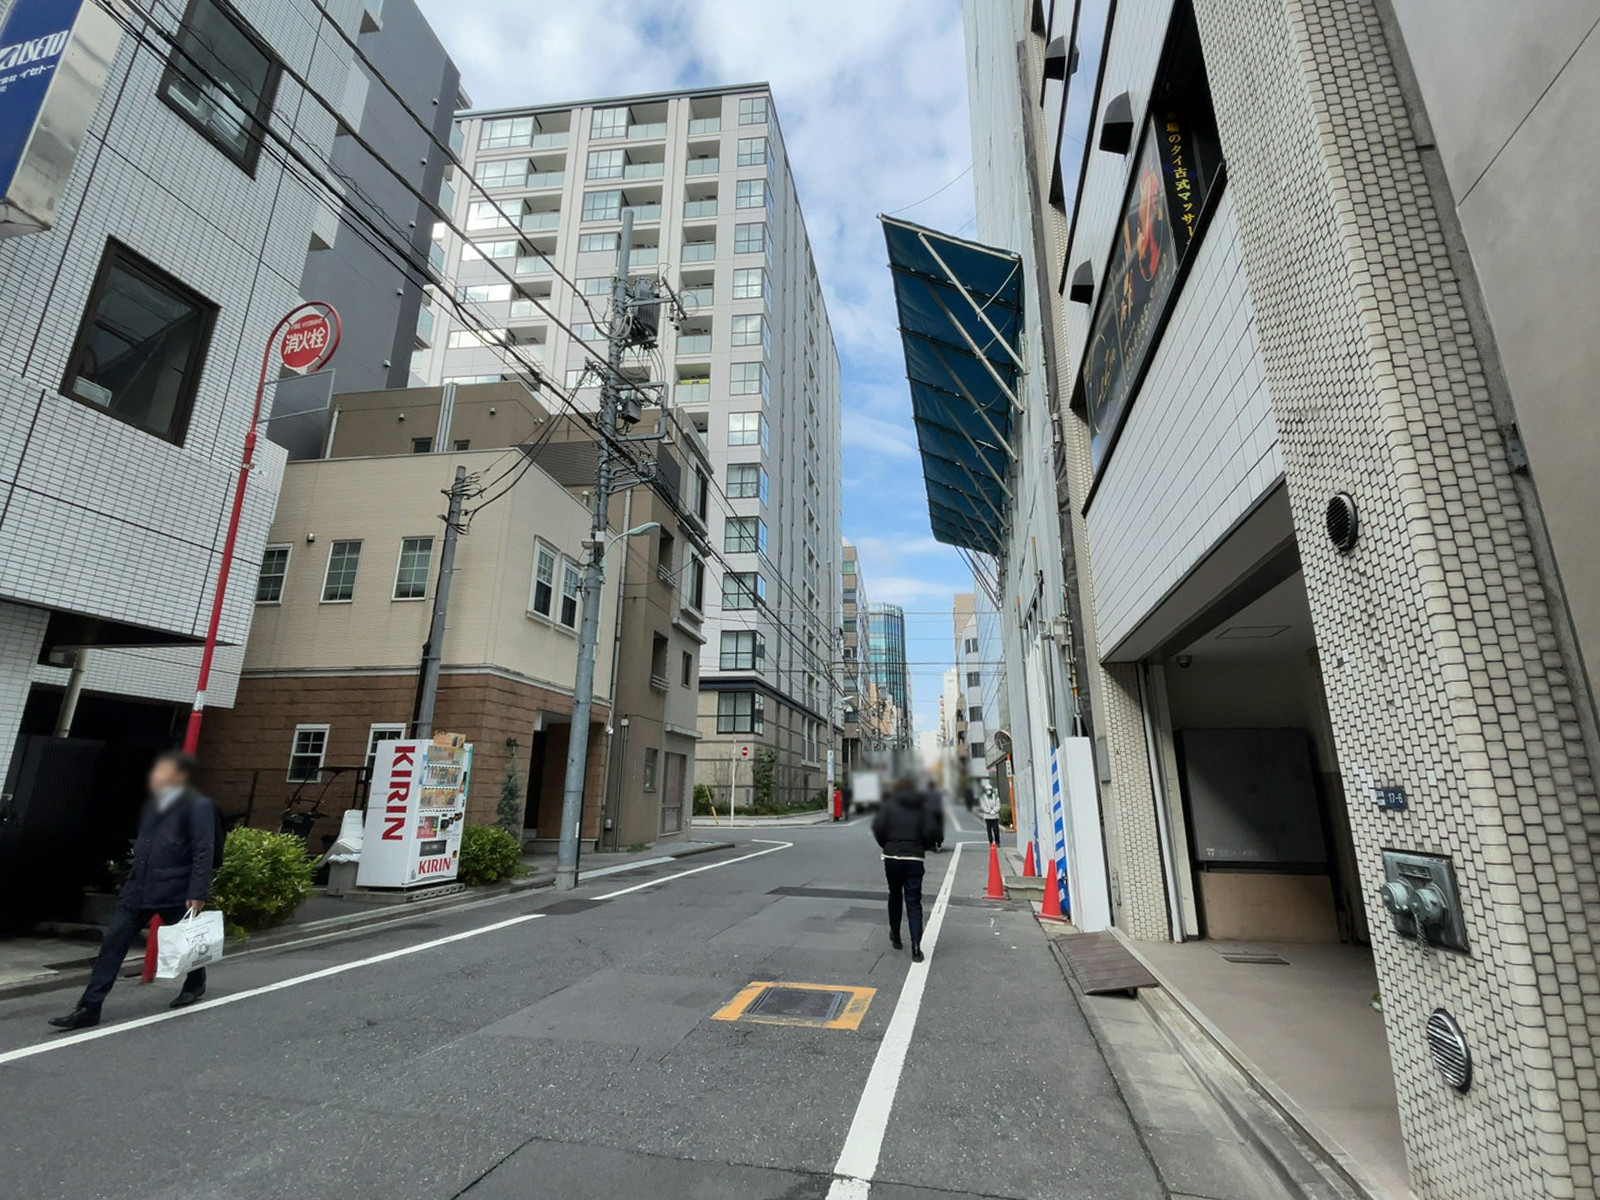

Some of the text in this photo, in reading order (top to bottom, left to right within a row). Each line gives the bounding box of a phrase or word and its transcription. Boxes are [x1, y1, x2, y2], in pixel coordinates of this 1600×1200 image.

[19, 65, 55, 79] イセトー
[284, 327, 326, 354] 消火栓
[381, 746, 416, 840] KIRIN
[1387, 792, 1404, 804] 17-6
[418, 858, 451, 874] KIRIN
